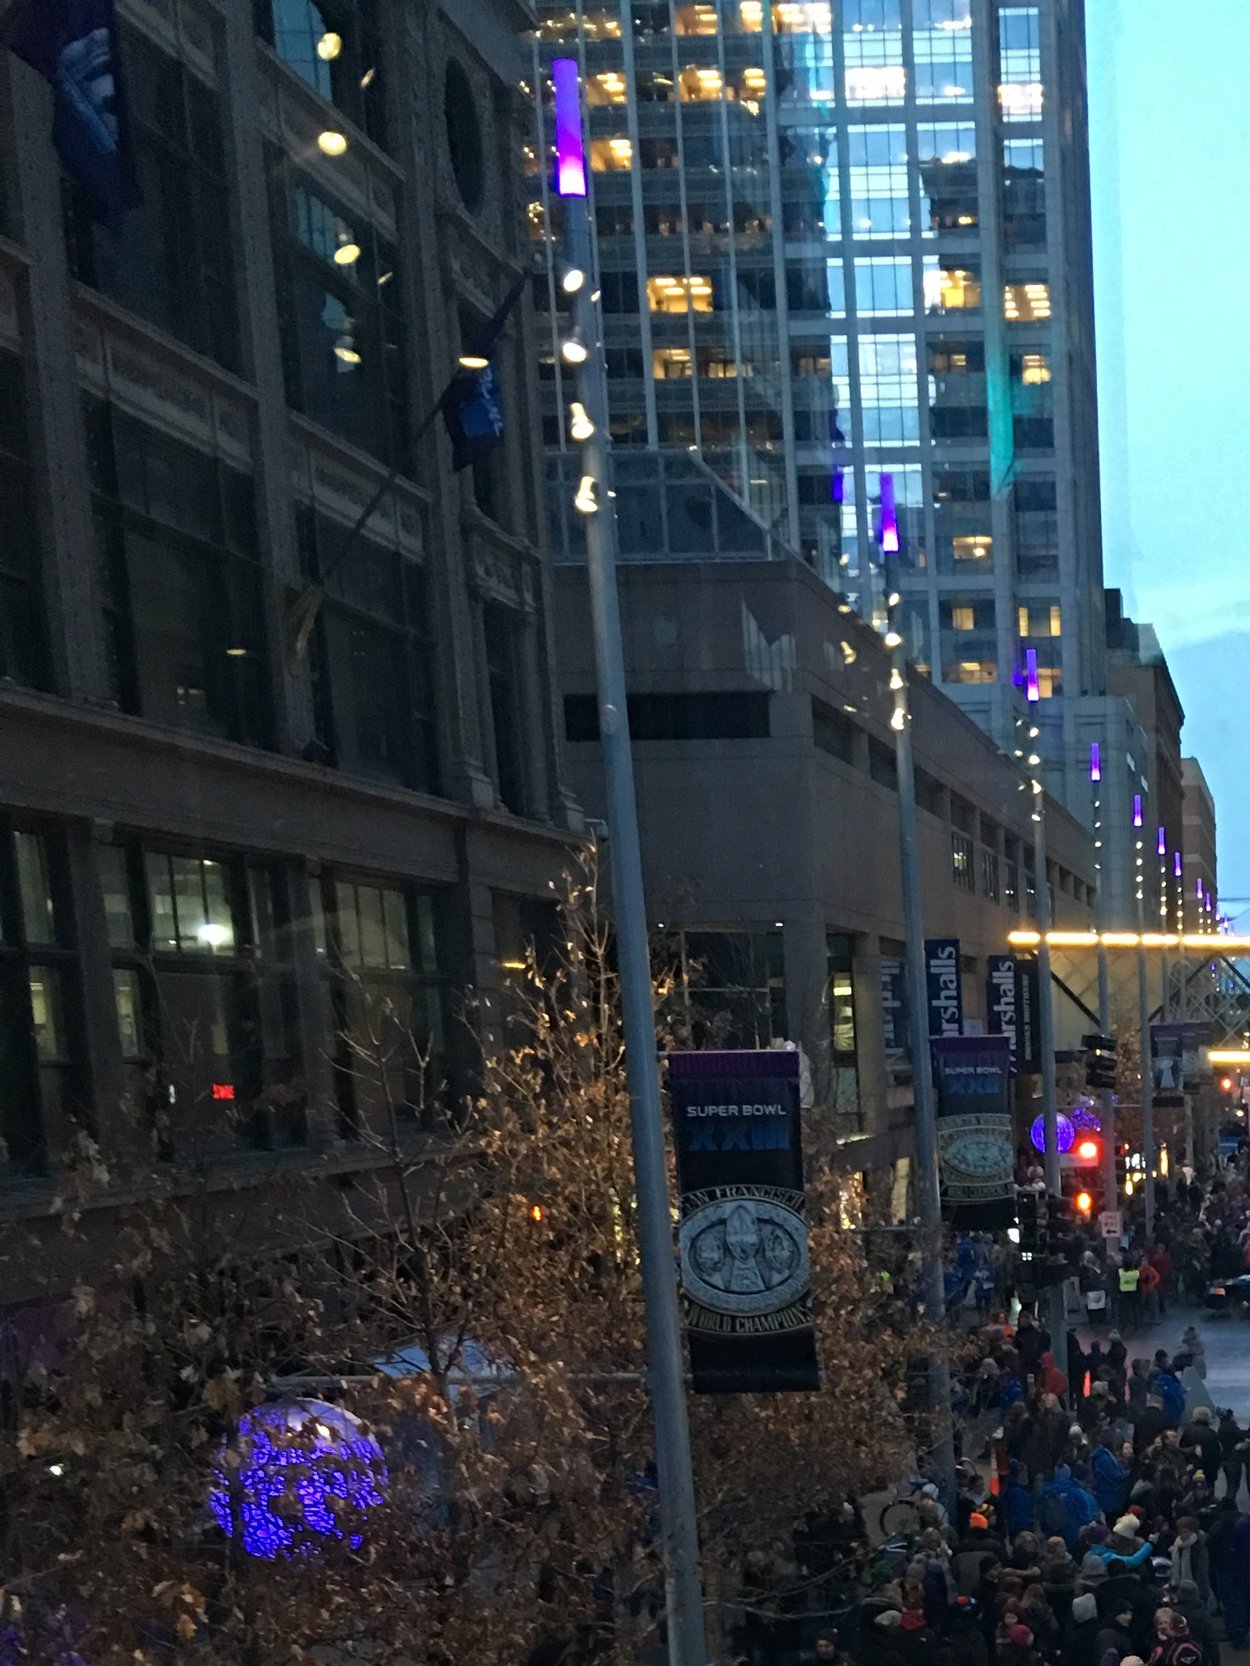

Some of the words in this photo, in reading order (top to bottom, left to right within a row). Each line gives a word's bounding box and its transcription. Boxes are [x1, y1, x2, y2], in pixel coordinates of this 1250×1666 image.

[930, 946, 959, 1037] rshalls
[992, 960, 1017, 1073] arshalls
[686, 1105, 739, 1117] SUPER
[742, 1104, 786, 1116] BOWL
